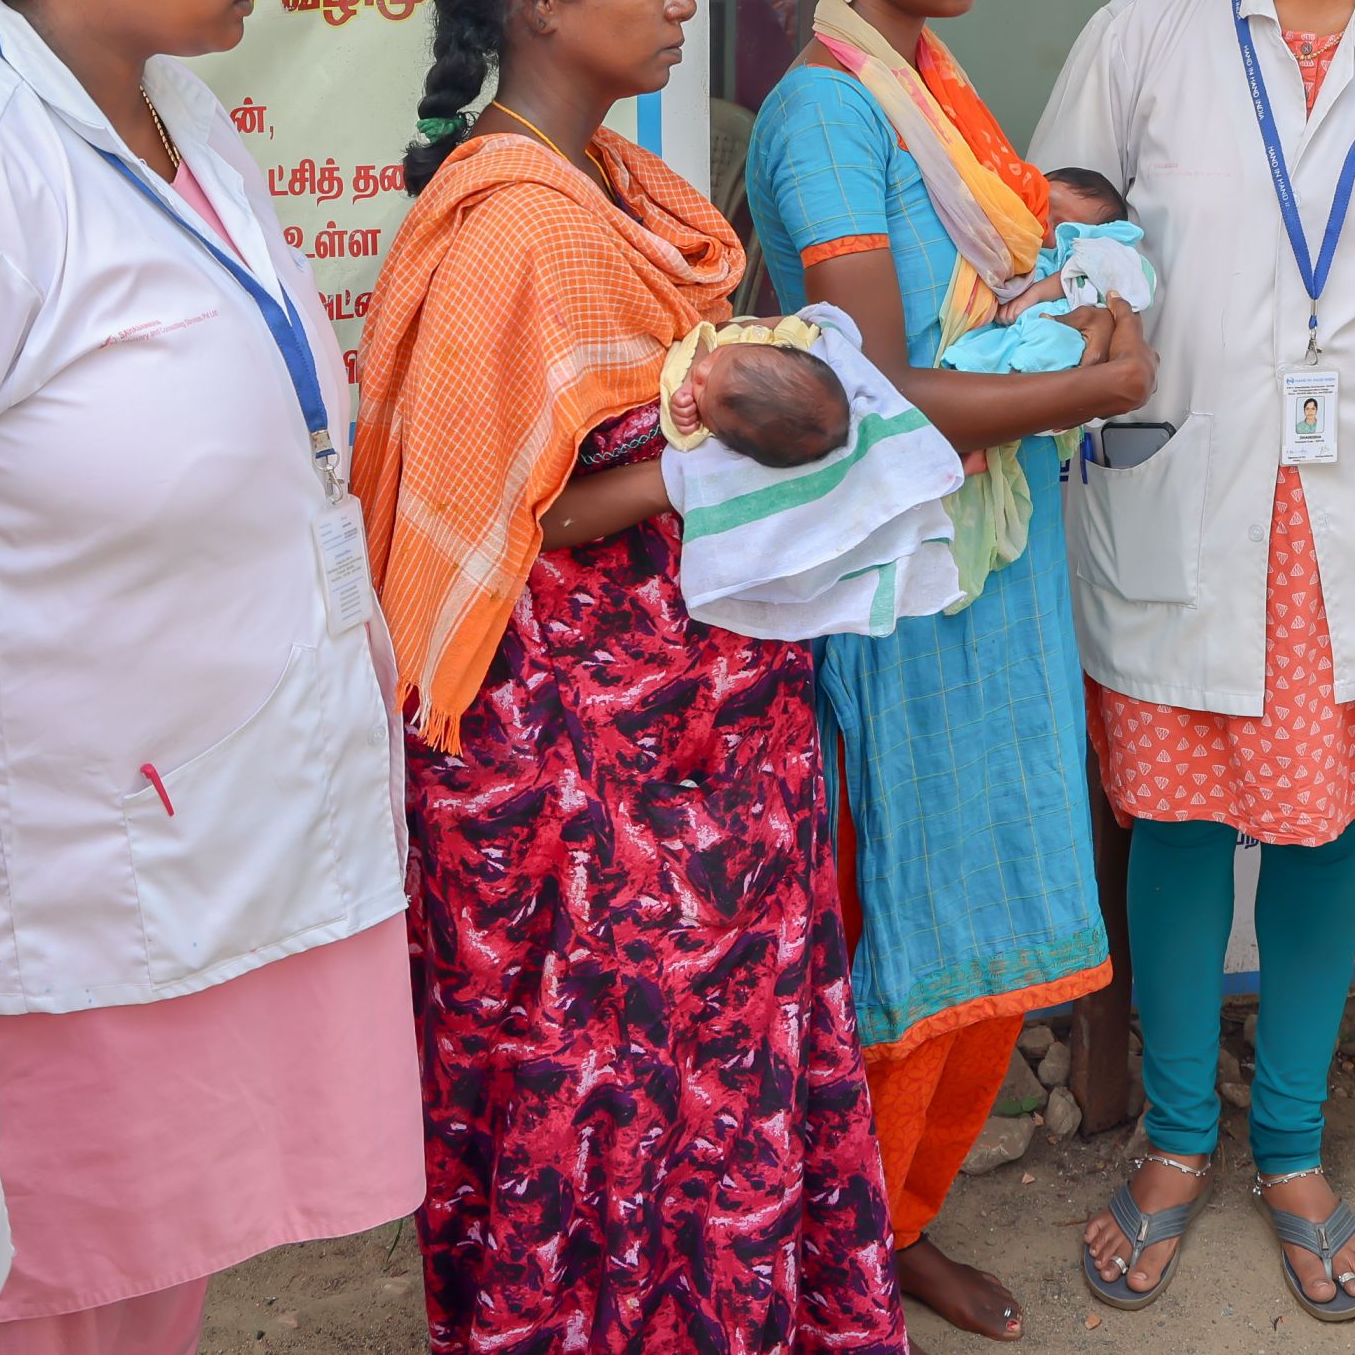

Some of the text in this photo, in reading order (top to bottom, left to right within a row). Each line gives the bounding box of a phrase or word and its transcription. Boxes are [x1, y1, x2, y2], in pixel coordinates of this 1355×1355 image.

[1244, 45, 1253, 66] HAND
[1250, 77, 1260, 98] HAND
[1268, 146, 1279, 167] HAND
[1278, 179, 1289, 201] HAND
